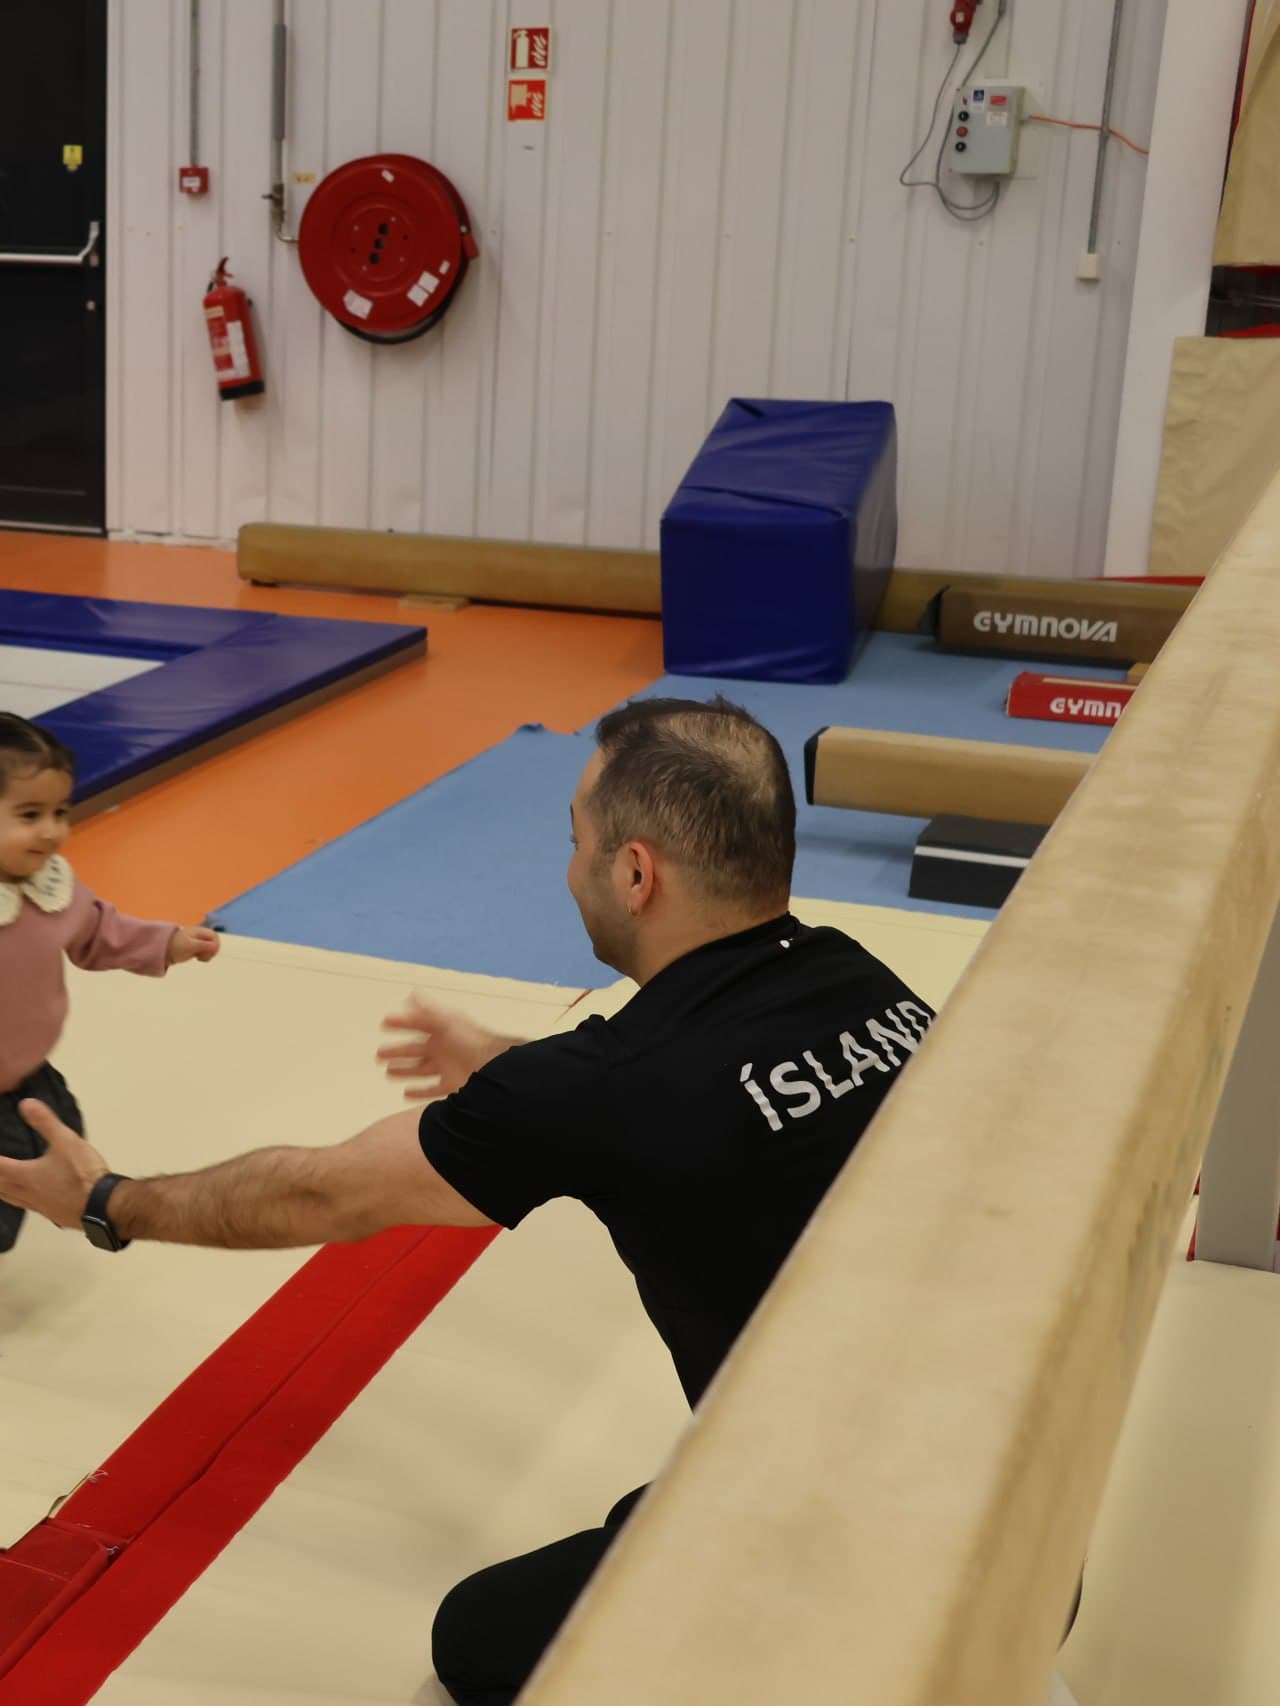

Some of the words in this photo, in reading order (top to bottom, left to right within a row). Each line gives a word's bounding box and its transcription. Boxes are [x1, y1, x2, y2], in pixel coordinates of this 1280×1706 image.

[973, 611, 1118, 643] GYMNOVA
[1049, 697, 1124, 718] GYMN
[739, 1000, 933, 1132] ÍSLAND
